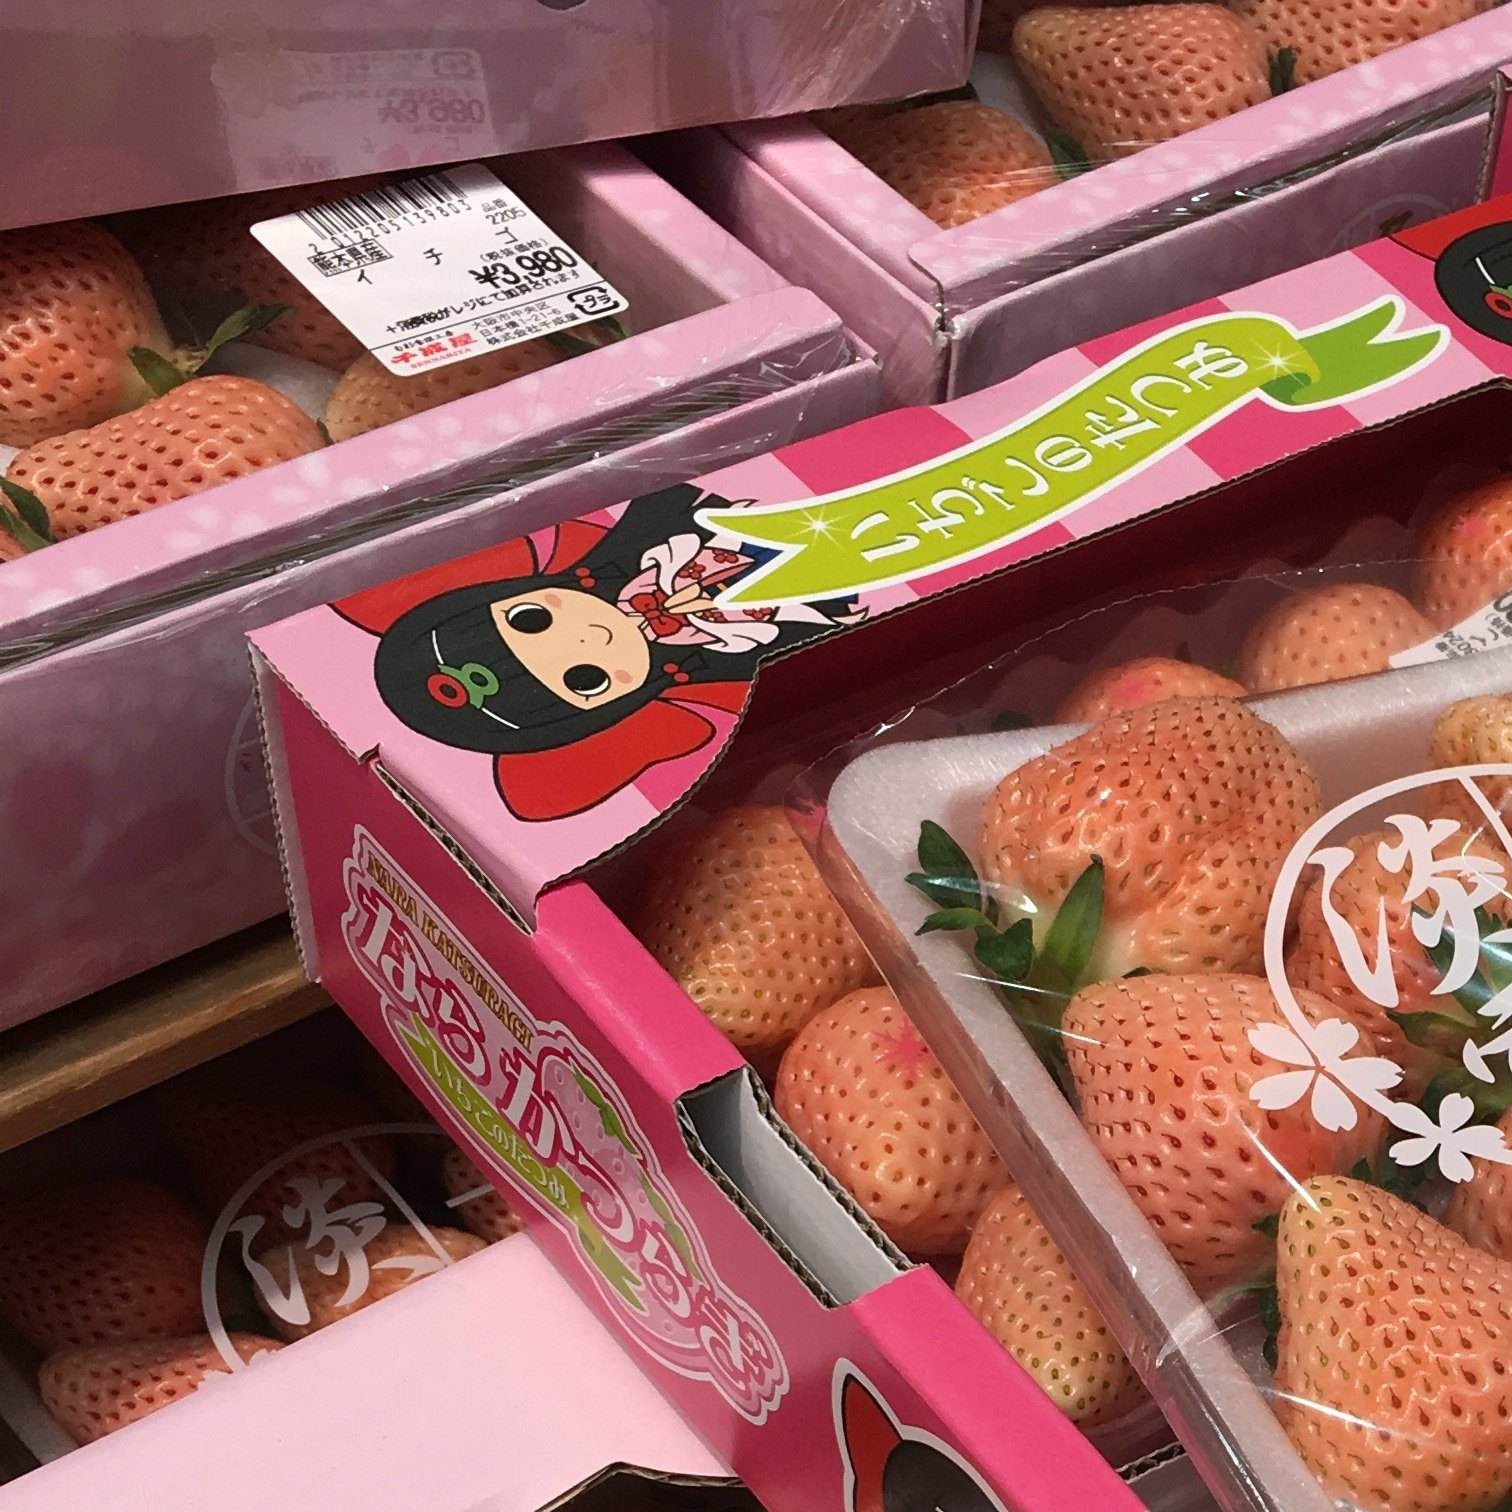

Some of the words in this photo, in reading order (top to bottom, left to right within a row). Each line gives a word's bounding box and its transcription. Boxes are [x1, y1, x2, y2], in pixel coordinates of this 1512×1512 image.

[477, 197, 510, 213] 品番
[483, 205, 528, 226] 2205
[309, 239, 391, 276] 熊本県産
[850, 340, 1250, 563] いちごのたつみ
[354, 888, 778, 1396] ならかつらぎ
